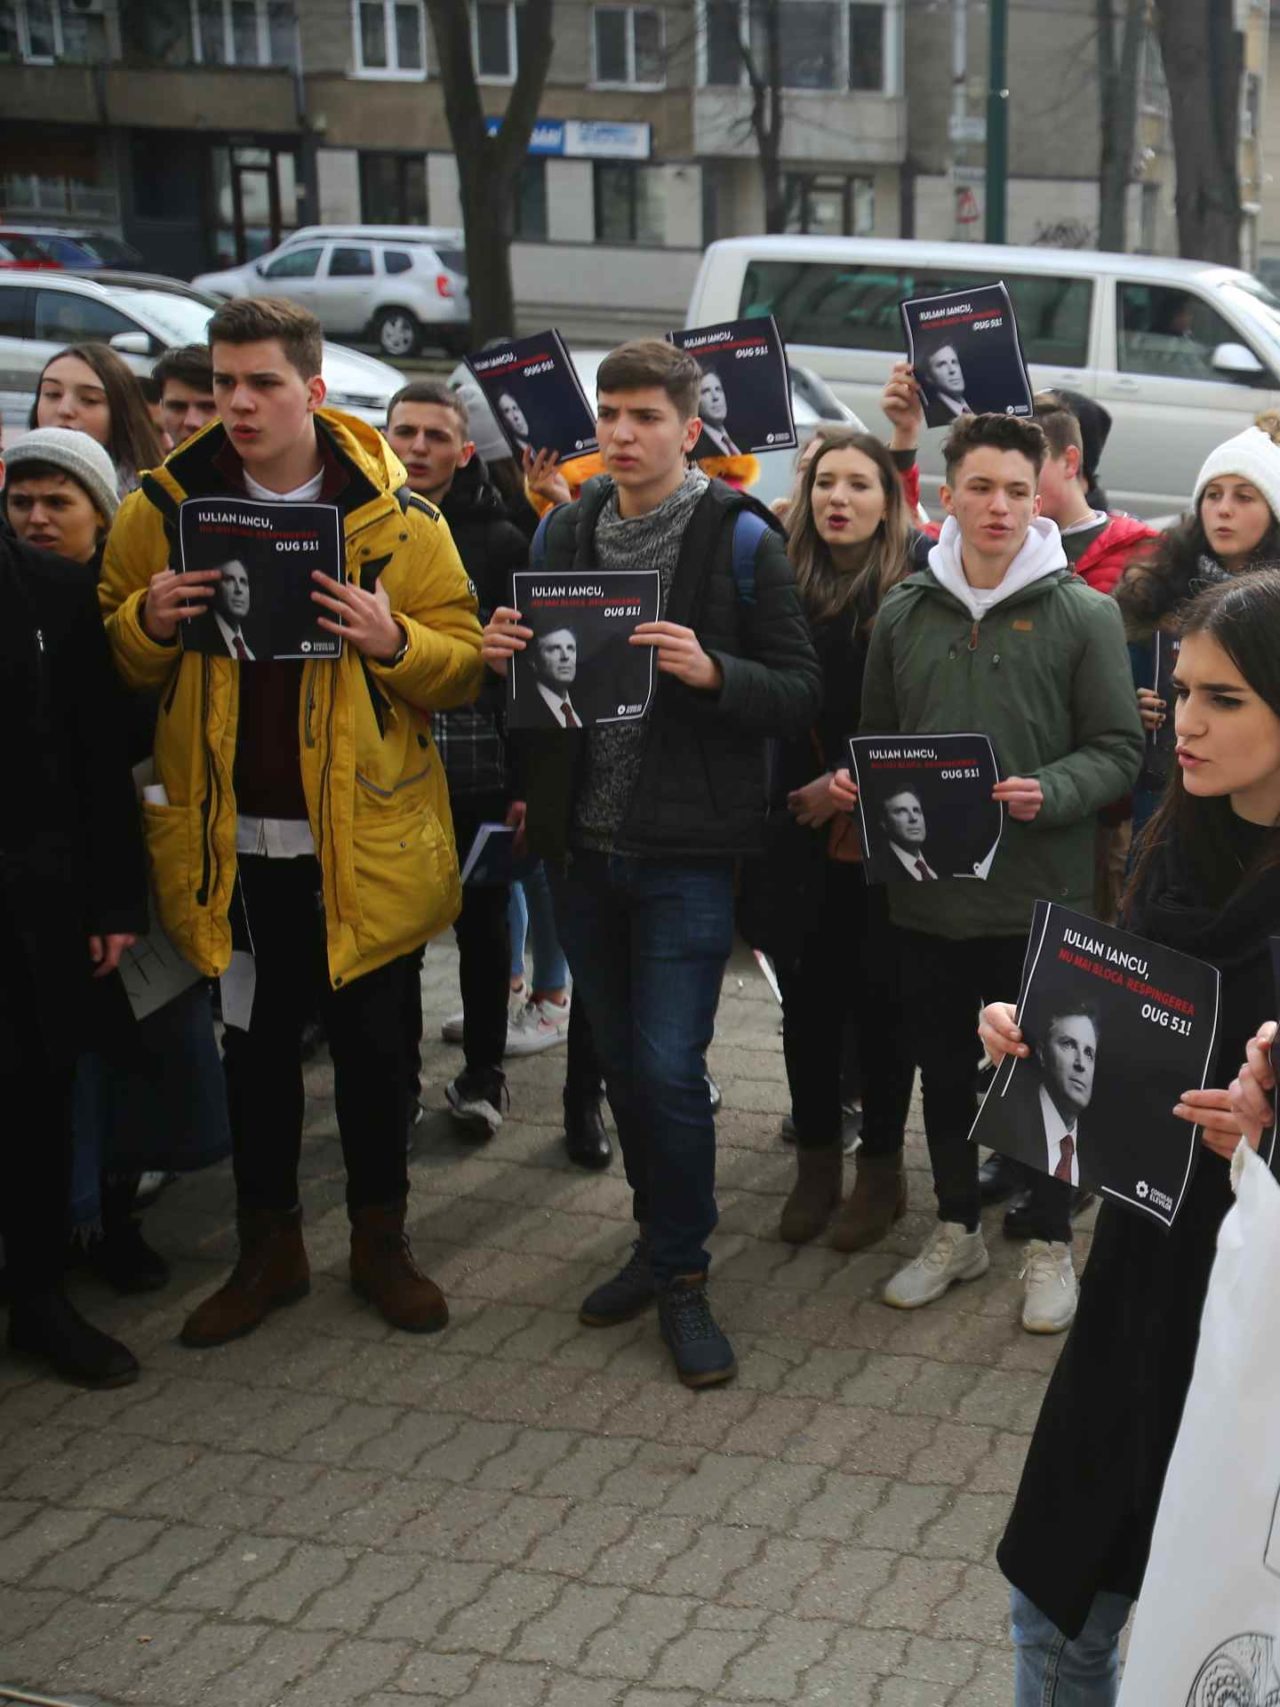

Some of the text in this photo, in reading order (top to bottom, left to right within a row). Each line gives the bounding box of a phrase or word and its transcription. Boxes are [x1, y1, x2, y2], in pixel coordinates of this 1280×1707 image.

[972, 320, 990, 331] OUG
[735, 346, 755, 359] OUG
[198, 512, 274, 531] IULIAN IANCU,
[275, 540, 319, 551] OUG 51!
[532, 586, 604, 598] IULIAN IANCU,
[604, 606, 641, 617] OUG 51!
[869, 749, 938, 760] IULIAN IANCU,
[941, 768, 980, 779] OUG 51!
[1063, 928, 1150, 980] IULIAN IANCU,
[1058, 947, 1197, 1017] NU MAI BLOCA RESPINGEREA
[1141, 1004, 1192, 1037] OUG 51!
